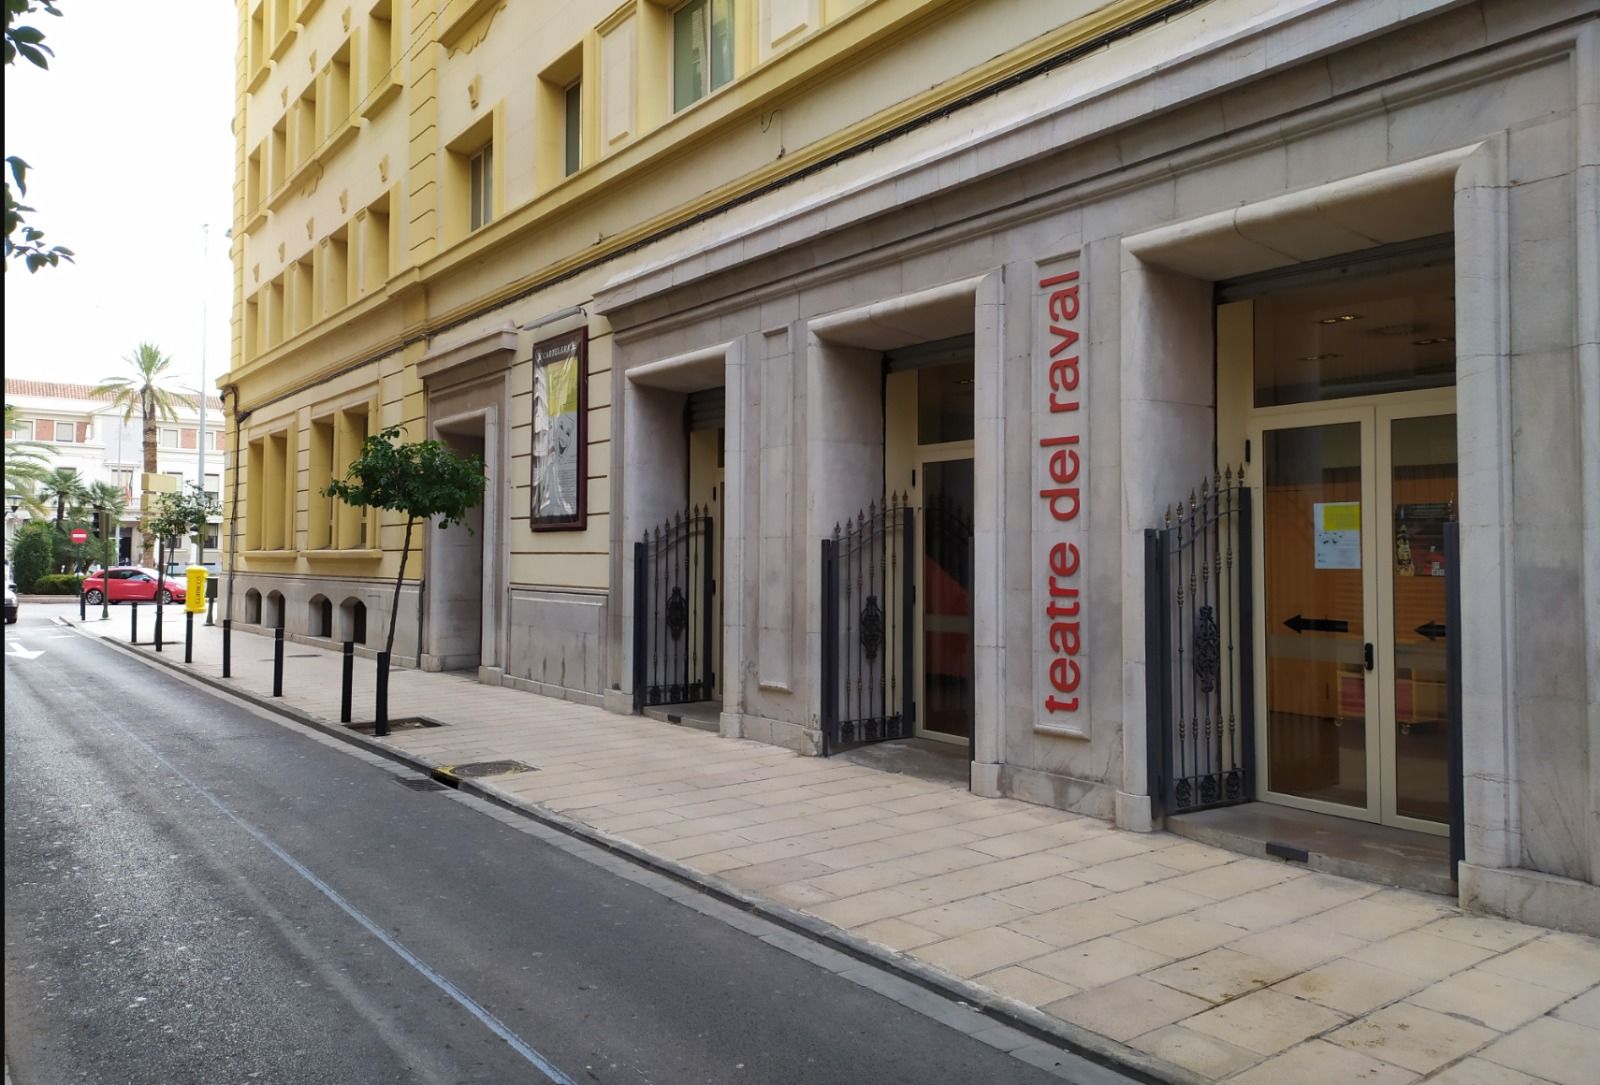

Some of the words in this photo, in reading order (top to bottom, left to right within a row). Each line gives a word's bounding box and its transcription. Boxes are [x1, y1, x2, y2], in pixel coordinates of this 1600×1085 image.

[1039, 271, 1079, 413] raval
[1039, 434, 1079, 520] del
[1045, 542, 1081, 712] teatre
